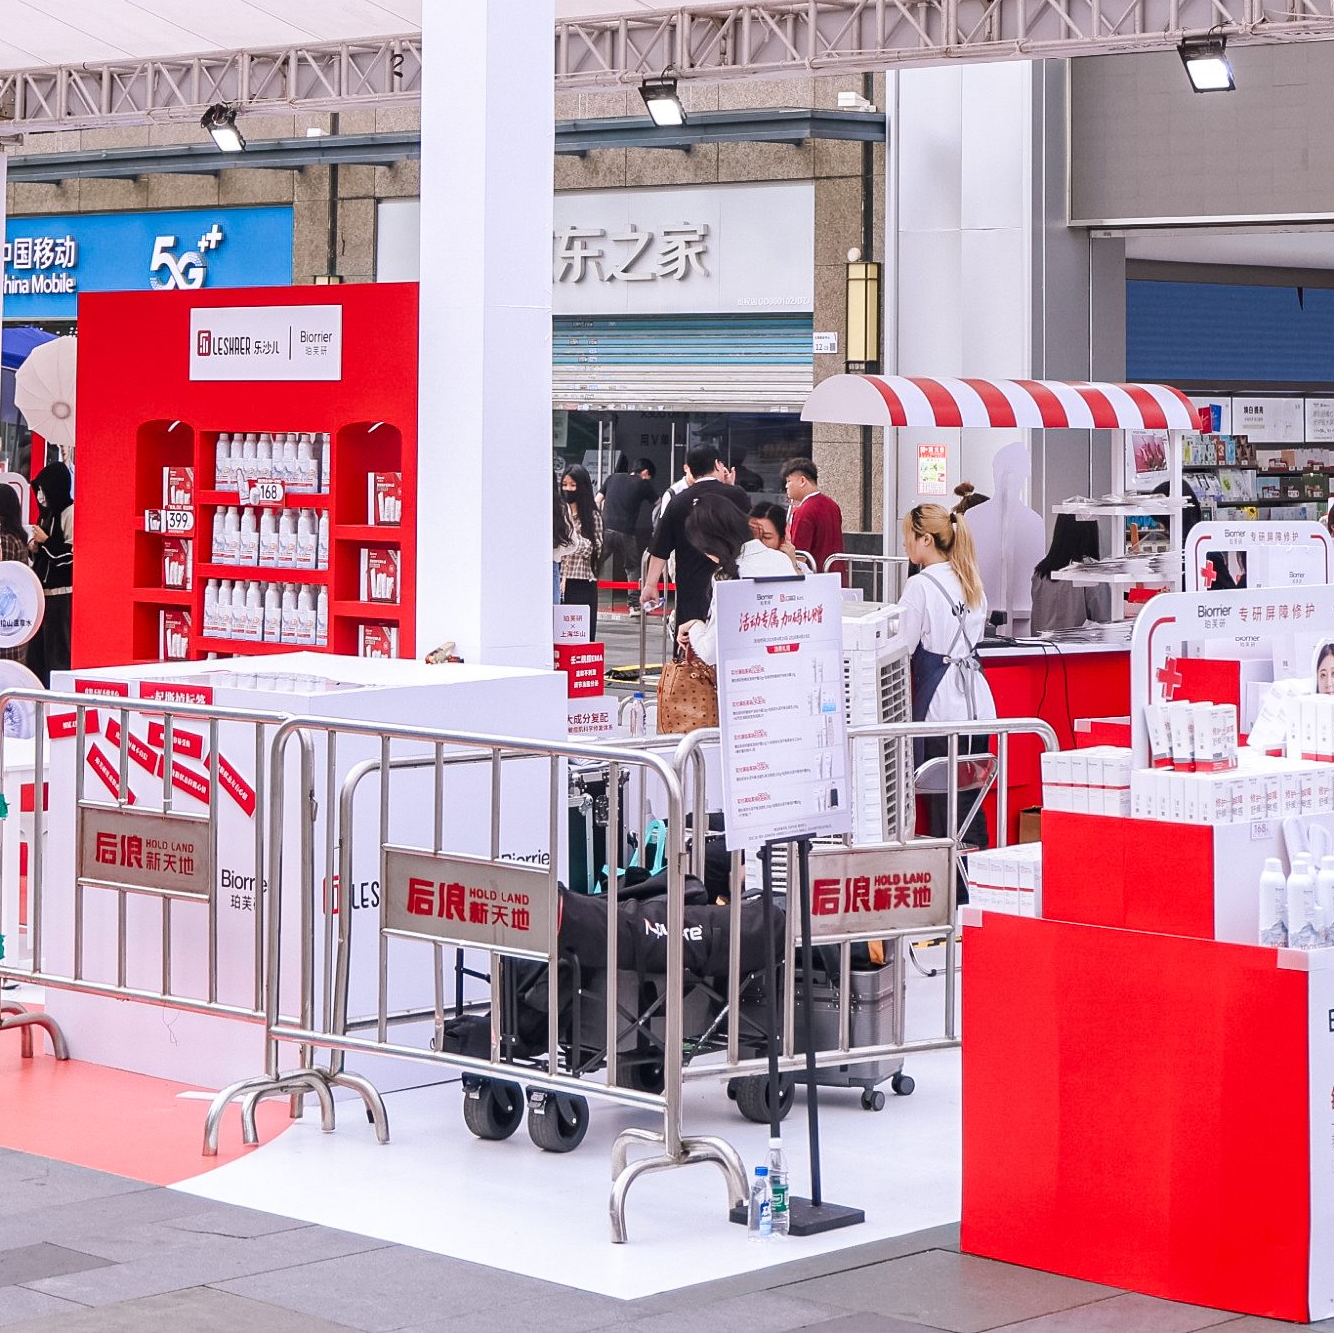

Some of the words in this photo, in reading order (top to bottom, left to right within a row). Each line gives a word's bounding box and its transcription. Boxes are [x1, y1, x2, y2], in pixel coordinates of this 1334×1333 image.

[554, 222, 710, 283] 东之家
[4, 273, 28, 293] hina
[31, 272, 76, 293] Mobile
[254, 338, 280, 354] 乐沙儿
[300, 330, 332, 345] Biorrier
[305, 346, 328, 356] 珀芙研
[260, 484, 277, 499] 168
[169, 512, 188, 528] 399
[739, 607, 779, 632] 活动专属
[1197, 605, 1233, 618] Biorrier
[1238, 604, 1316, 622] 专研屏障修护
[96, 832, 144, 869] 后浪
[146, 839, 168, 851] HOLD
[170, 841, 194, 853] LAND
[146, 854, 194, 877] 新天地
[873, 874, 901, 889] HOLD
[904, 871, 932, 887] LAND
[407, 877, 466, 922] 后浪
[469, 888, 497, 903] HOLD
[501, 892, 530, 906] LAND
[811, 877, 871, 916] 后浪
[873, 886, 931, 910] 新天地
[469, 903, 530, 933] 新天地
